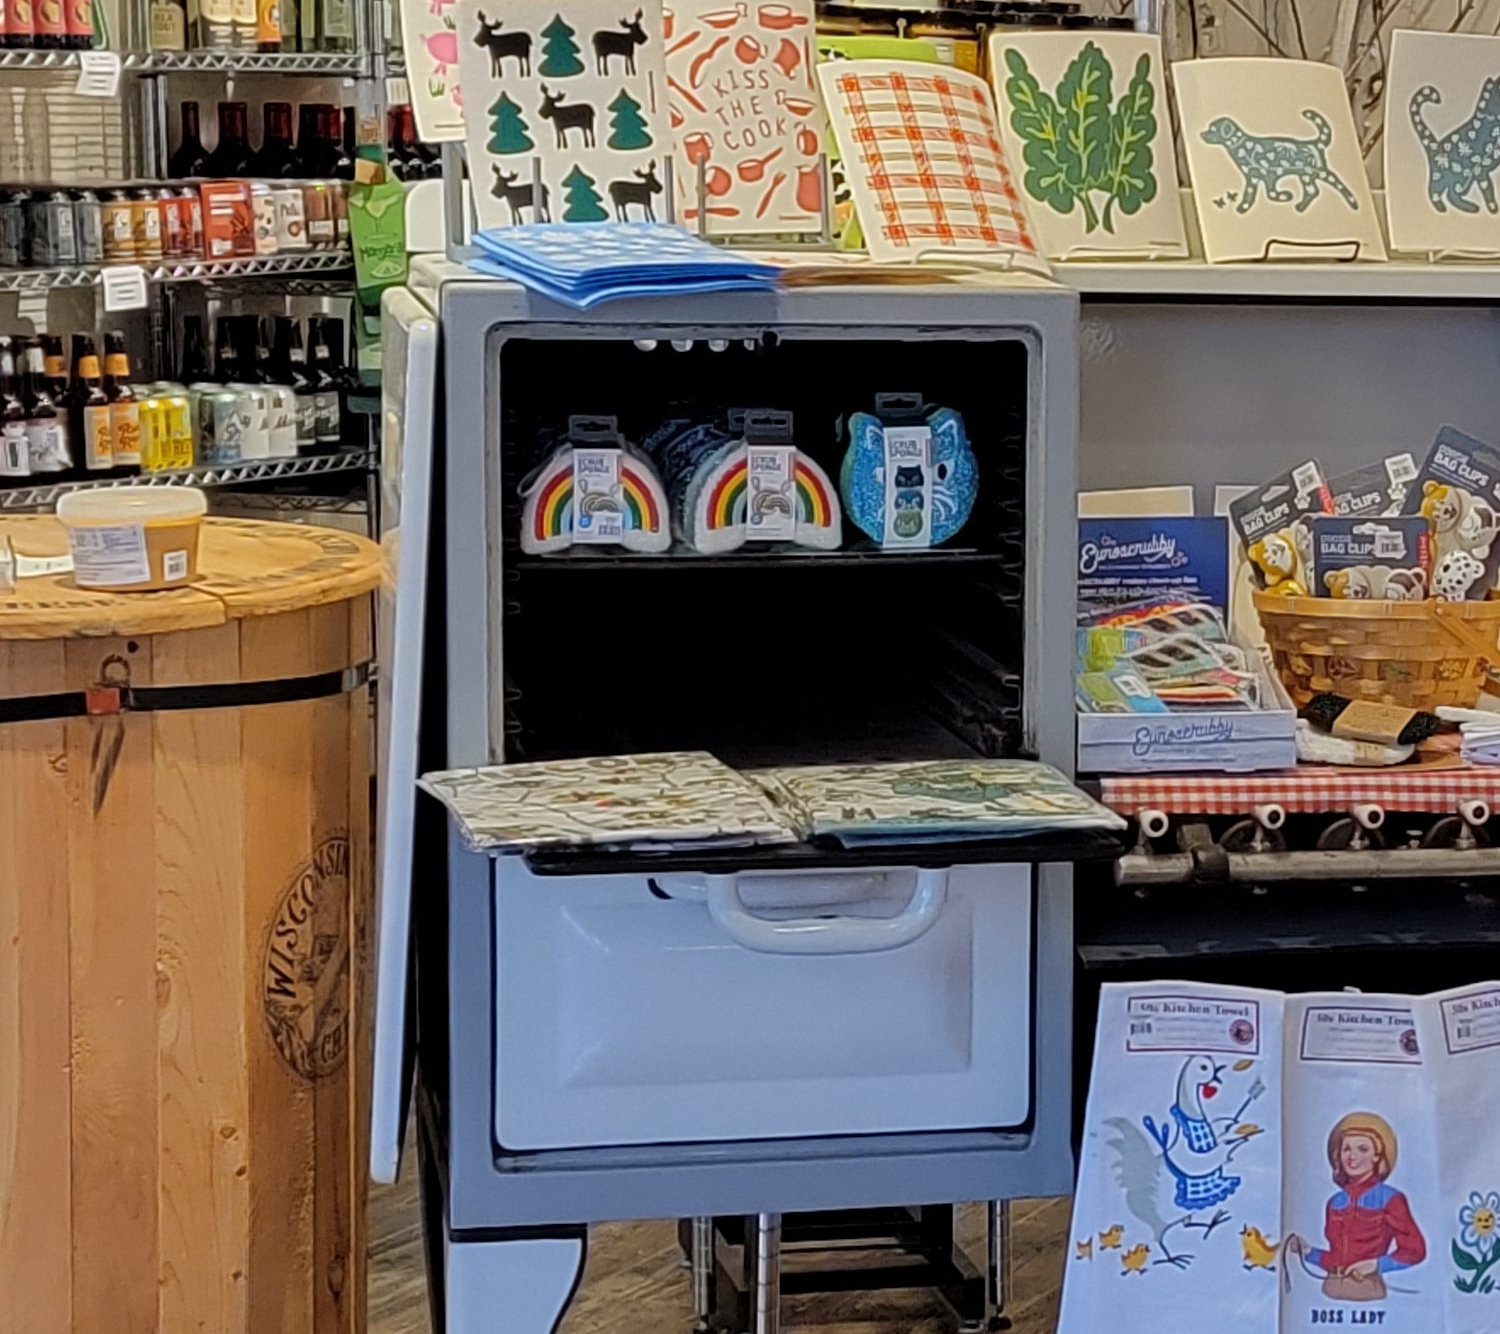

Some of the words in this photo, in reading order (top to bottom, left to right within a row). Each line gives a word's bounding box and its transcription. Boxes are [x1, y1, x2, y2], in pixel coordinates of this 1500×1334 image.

[713, 69, 770, 98] KISS
[715, 95, 763, 126] THE
[723, 118, 787, 151] COOK
[1433, 451, 1459, 471] BAG
[1320, 543, 1345, 554] BAG
[1163, 1003, 1210, 1014] Kitchen
[1215, 1005, 1249, 1017] Towel
[1338, 1013, 1383, 1026] Kitchen
[1311, 1309, 1344, 1324] BOSS
[1350, 1309, 1386, 1325] LADY
